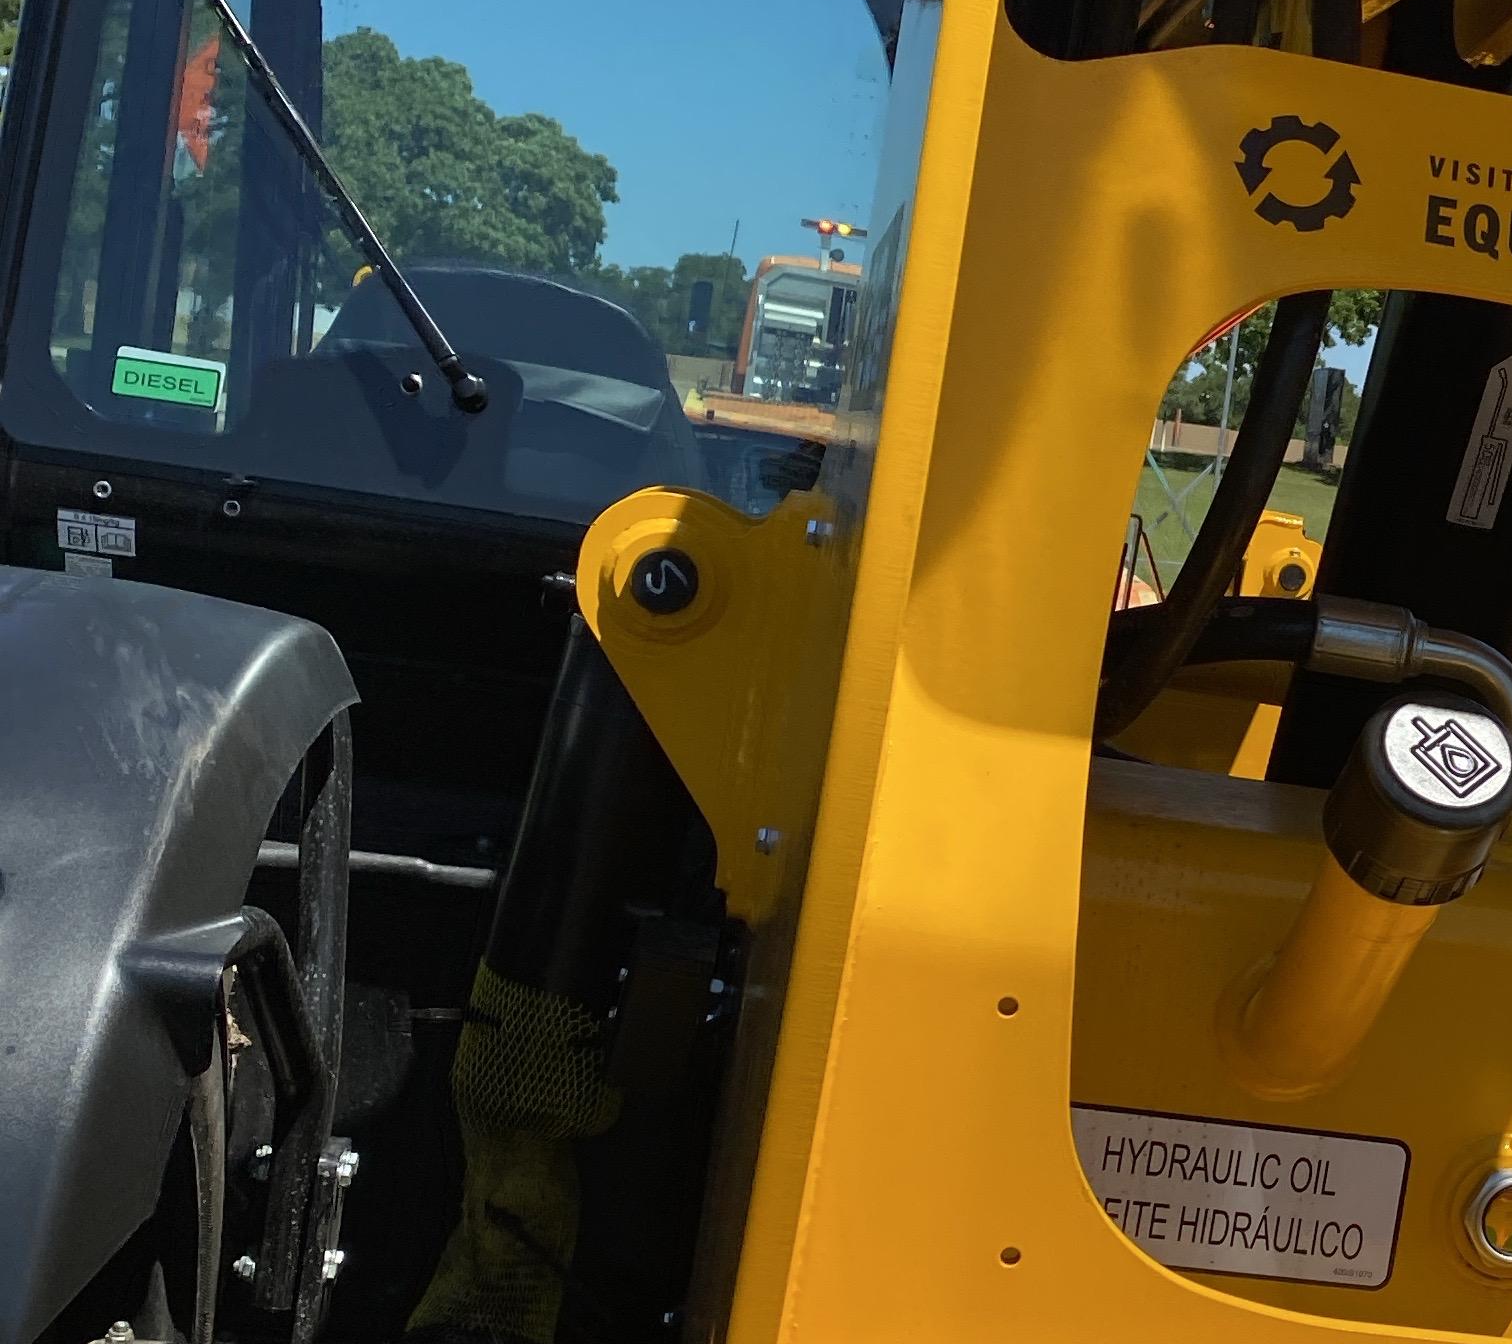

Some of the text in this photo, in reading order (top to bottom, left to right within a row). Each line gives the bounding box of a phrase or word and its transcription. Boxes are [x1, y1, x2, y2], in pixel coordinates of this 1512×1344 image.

[123, 370, 205, 395] DIESEL
[1101, 1135, 1337, 1197] HYDRAULIC OIL
[1176, 1206, 1364, 1260] HIDRÁULICO
